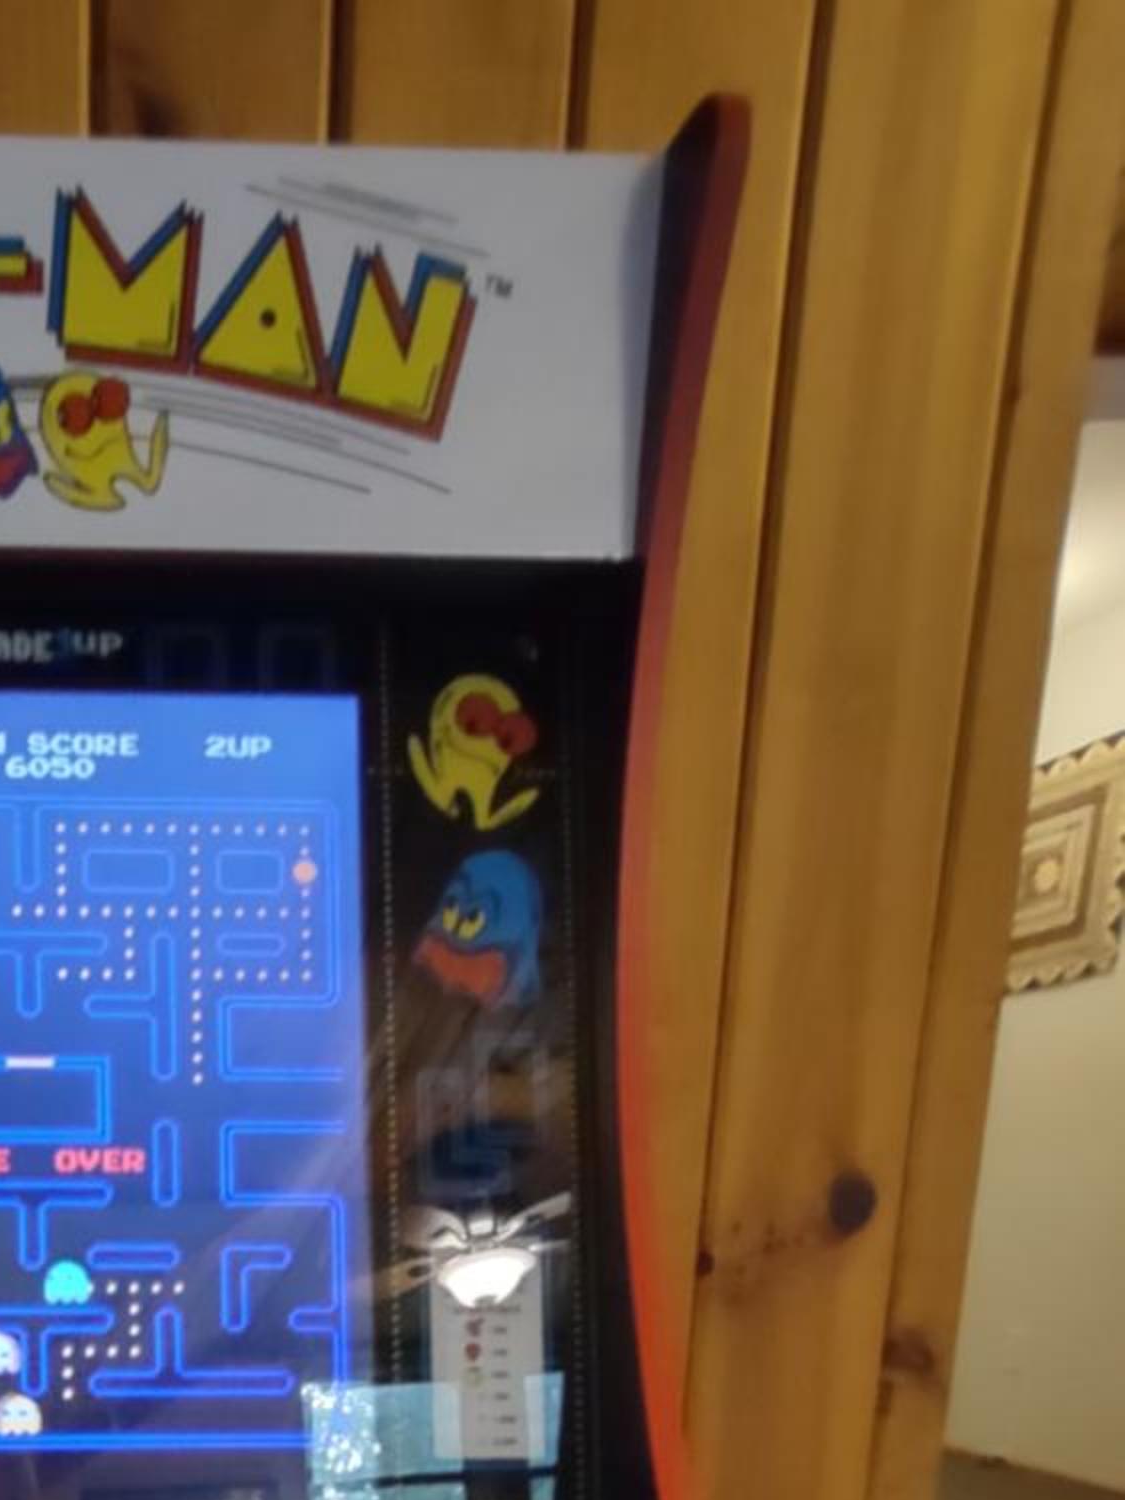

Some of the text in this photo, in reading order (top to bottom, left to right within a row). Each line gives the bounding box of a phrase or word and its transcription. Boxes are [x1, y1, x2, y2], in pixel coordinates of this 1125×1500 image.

[27, 733, 139, 757] SCORE
[205, 735, 271, 758] 2UP
[5, 756, 95, 779] 6050
[54, 1147, 145, 1174] OVER
